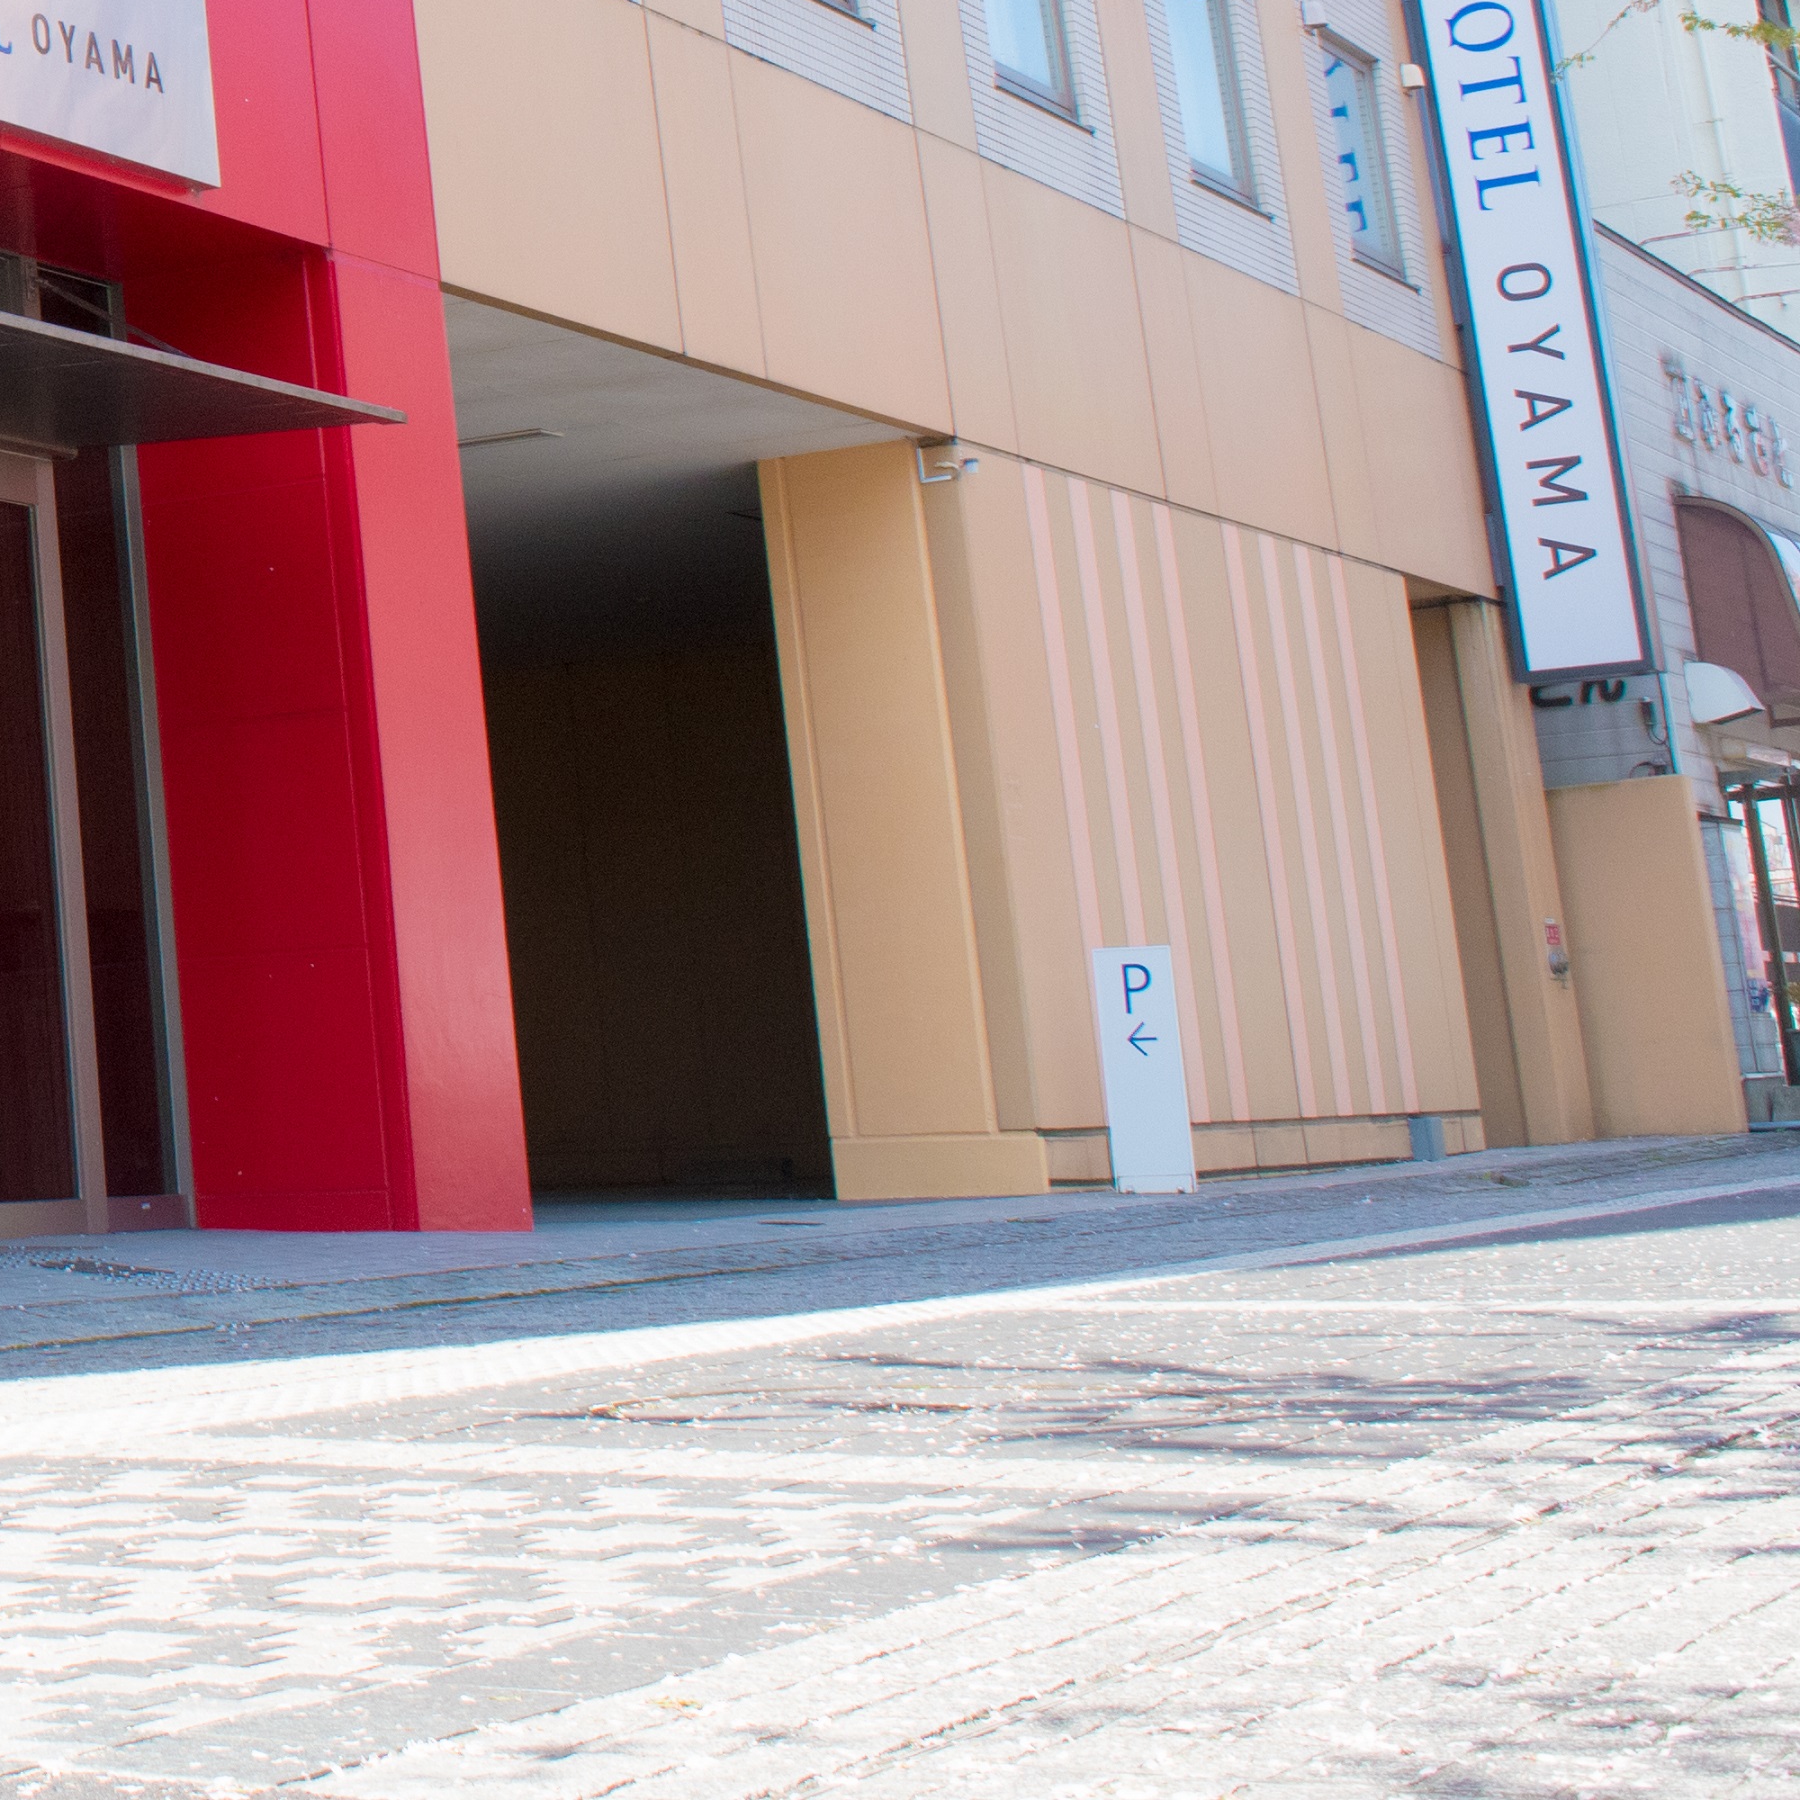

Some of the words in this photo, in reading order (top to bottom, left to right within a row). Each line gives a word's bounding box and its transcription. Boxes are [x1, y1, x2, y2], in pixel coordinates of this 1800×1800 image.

[30, 12, 165, 94] OYAMA
[1495, 262, 1597, 580] OYAMA
[1121, 963, 1152, 1014] P
